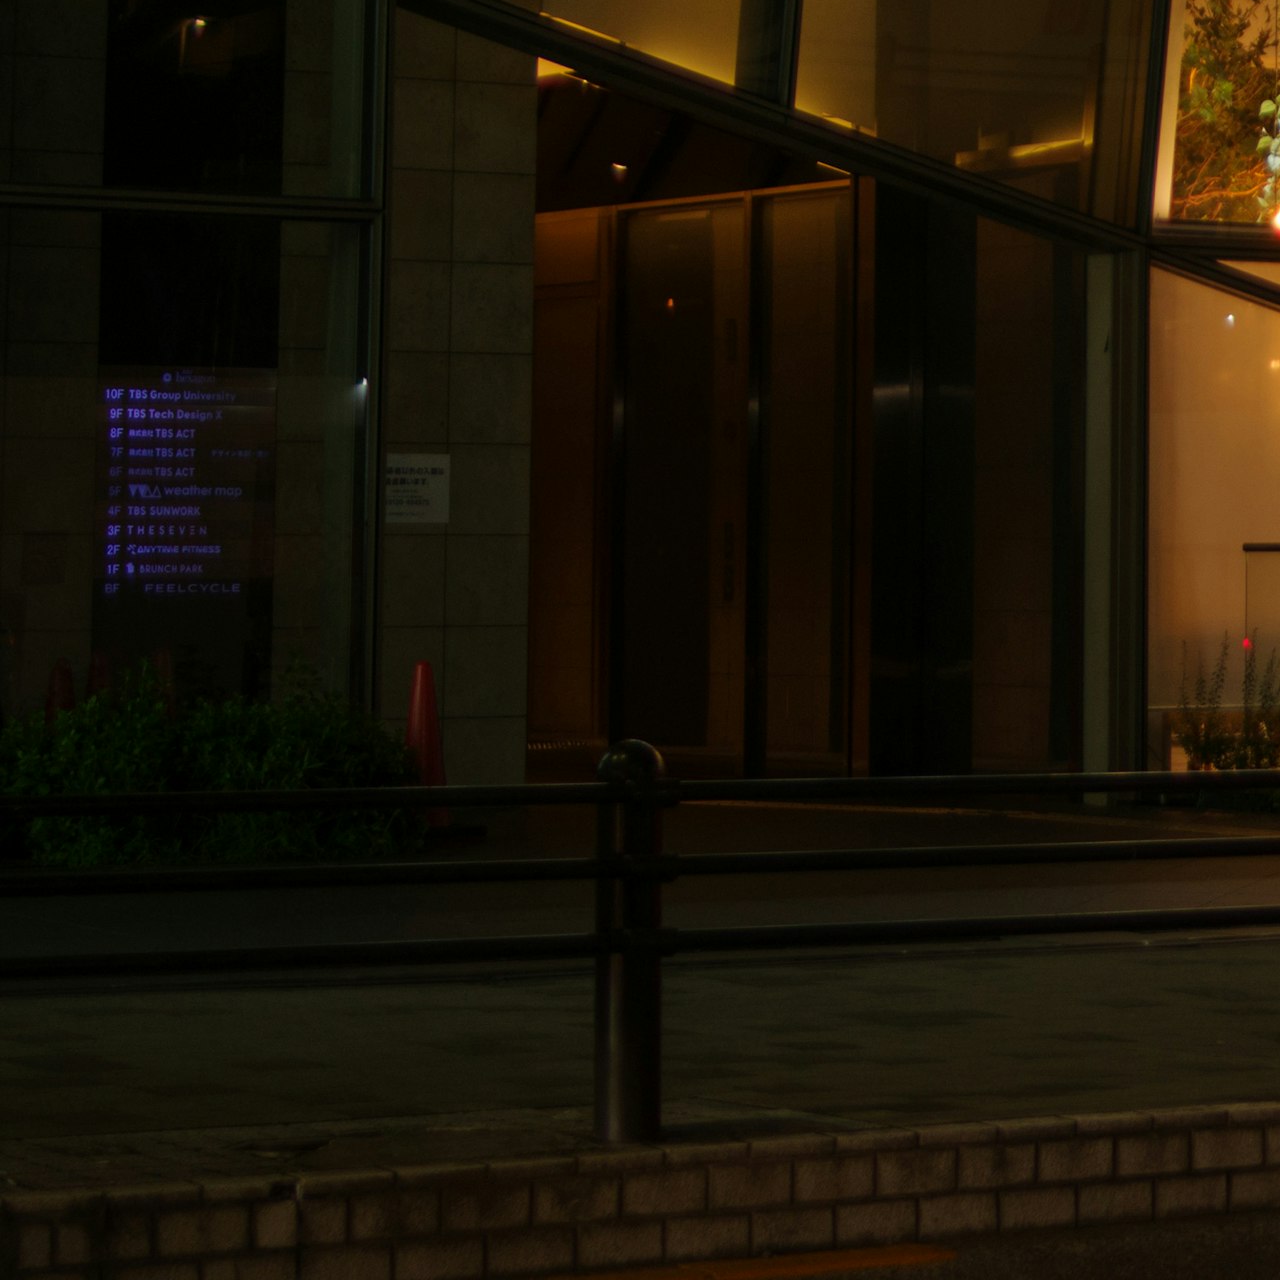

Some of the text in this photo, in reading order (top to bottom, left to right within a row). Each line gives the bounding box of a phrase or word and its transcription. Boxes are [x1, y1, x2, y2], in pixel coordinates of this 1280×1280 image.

[106, 389, 236, 402] 10F TBS Group University
[110, 408, 124, 419] 9F
[127, 408, 146, 419] TBS
[148, 408, 174, 420] Tech
[176, 409, 213, 422] Design
[110, 428, 124, 439] 8F
[155, 429, 173, 439] TBS
[176, 429, 196, 439] ACT
[111, 447, 124, 457] 7F
[155, 448, 173, 458] TBS
[176, 448, 196, 458] ACT
[155, 468, 173, 477] TBS
[175, 468, 195, 477] ACT
[163, 484, 212, 496] weather
[214, 486, 243, 498] map
[108, 506, 201, 516] 4F TBS SUNWORK
[107, 524, 121, 535] 3F
[107, 544, 222, 555] 2F ANYTIME FITNESS
[107, 564, 204, 574] 1F BRUNCH PARK
[144, 584, 241, 593] FEELCYCLE
